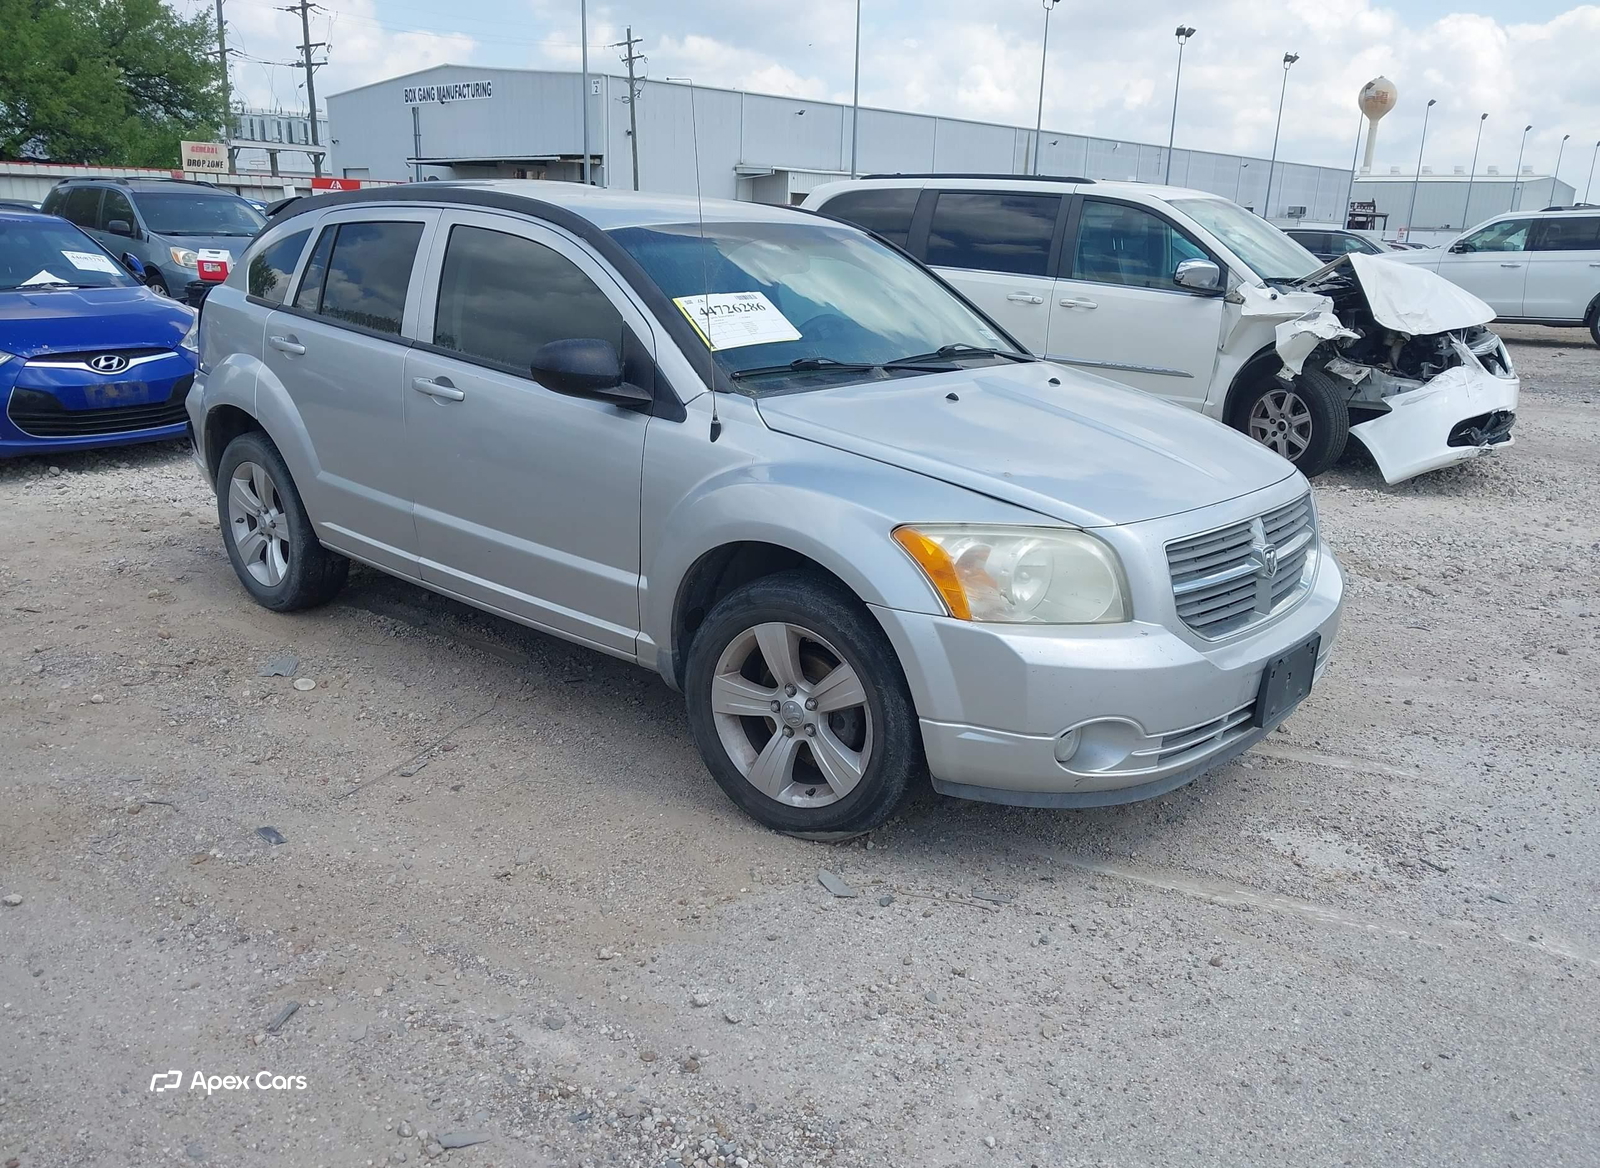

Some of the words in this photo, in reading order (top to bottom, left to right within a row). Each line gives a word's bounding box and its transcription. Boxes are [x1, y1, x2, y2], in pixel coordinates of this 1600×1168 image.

[404, 88, 417, 103] BOX
[418, 86, 435, 102] GANG
[436, 81, 492, 101] MANUFACTURING
[187, 158, 206, 168] DROP
[206, 159, 224, 169] ZONE
[699, 302, 766, 317] 44726286
